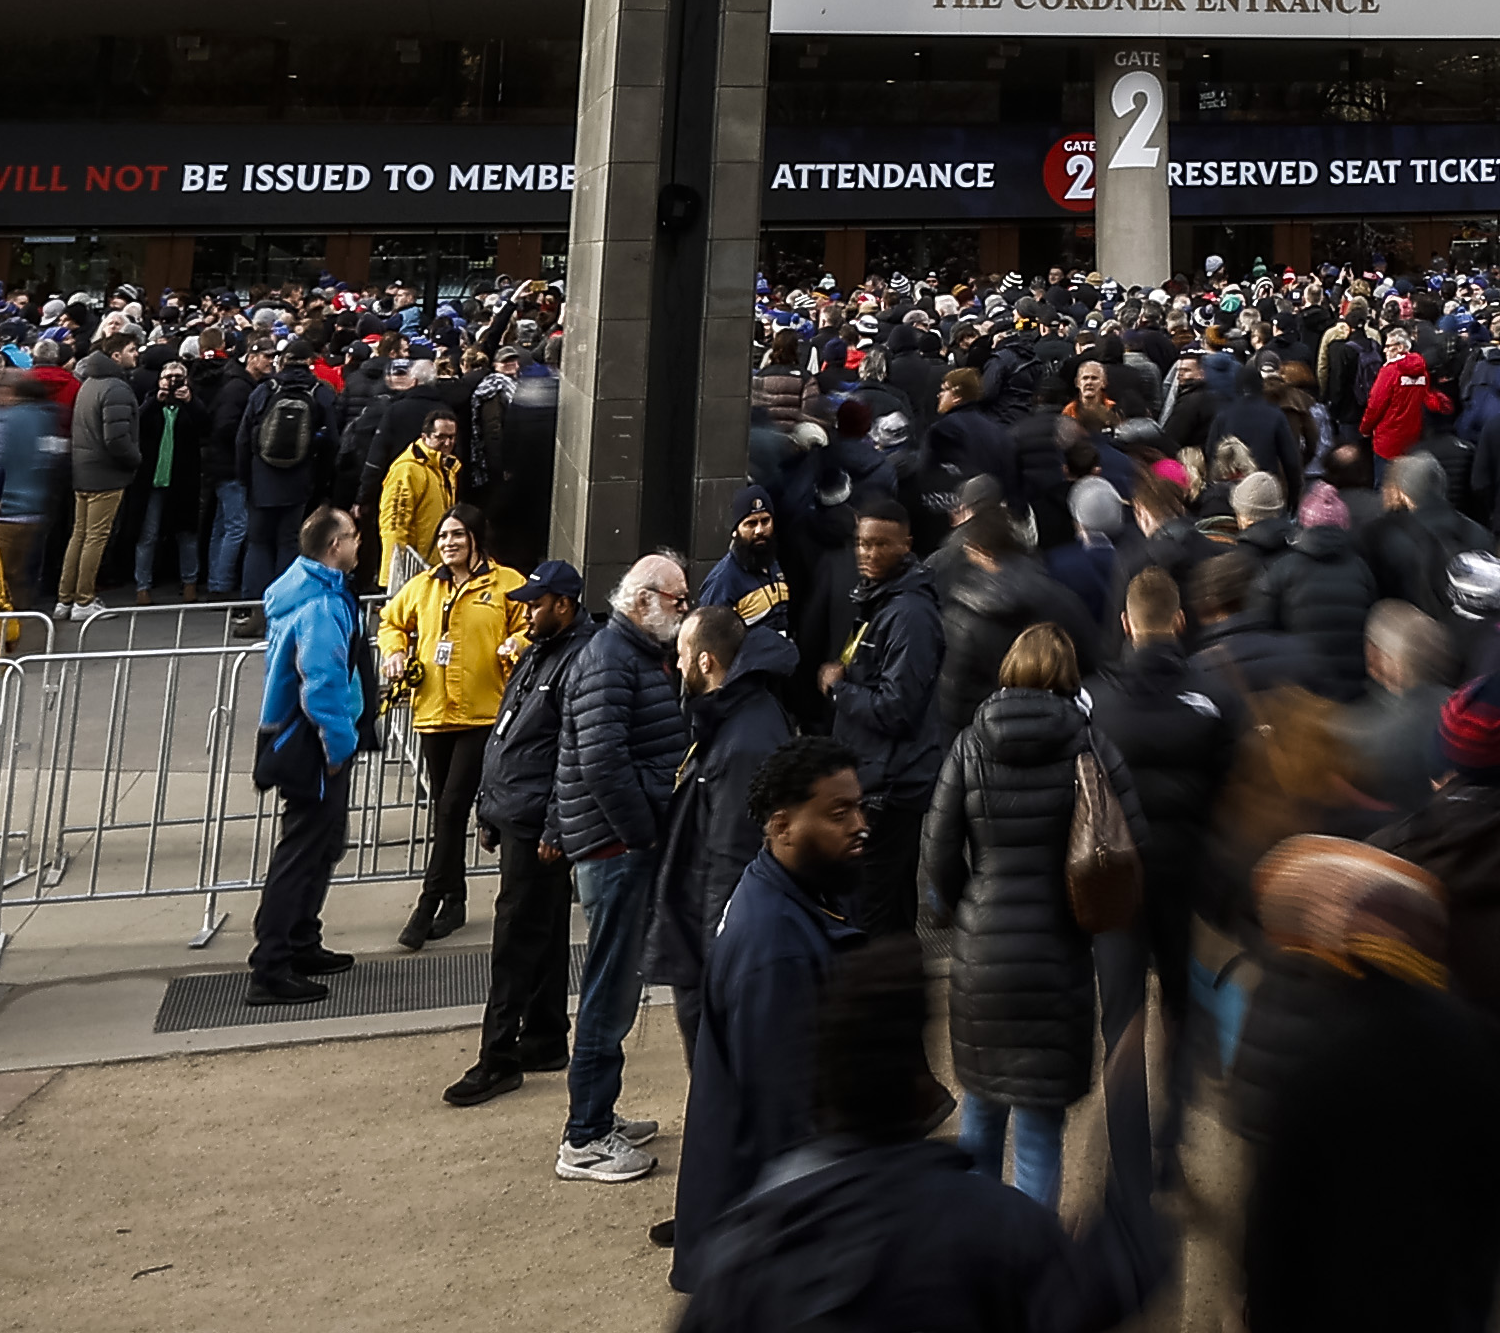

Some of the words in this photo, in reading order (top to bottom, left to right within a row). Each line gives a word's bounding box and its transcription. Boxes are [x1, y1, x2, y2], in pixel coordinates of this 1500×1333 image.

[1114, 50, 1161, 68] GATE
[1108, 70, 1164, 170] 2
[1063, 139, 1097, 153] GATE
[85, 164, 168, 193] NOT
[181, 164, 229, 193] BE
[242, 164, 372, 193] ISSUED
[384, 164, 435, 192] TO
[448, 164, 576, 192] MEMBE
[770, 162, 996, 190] ATTENDANCE
[1063, 154, 1096, 200] 2
[1168, 160, 1319, 187] RESERVED
[1330, 158, 1402, 185] SEAT
